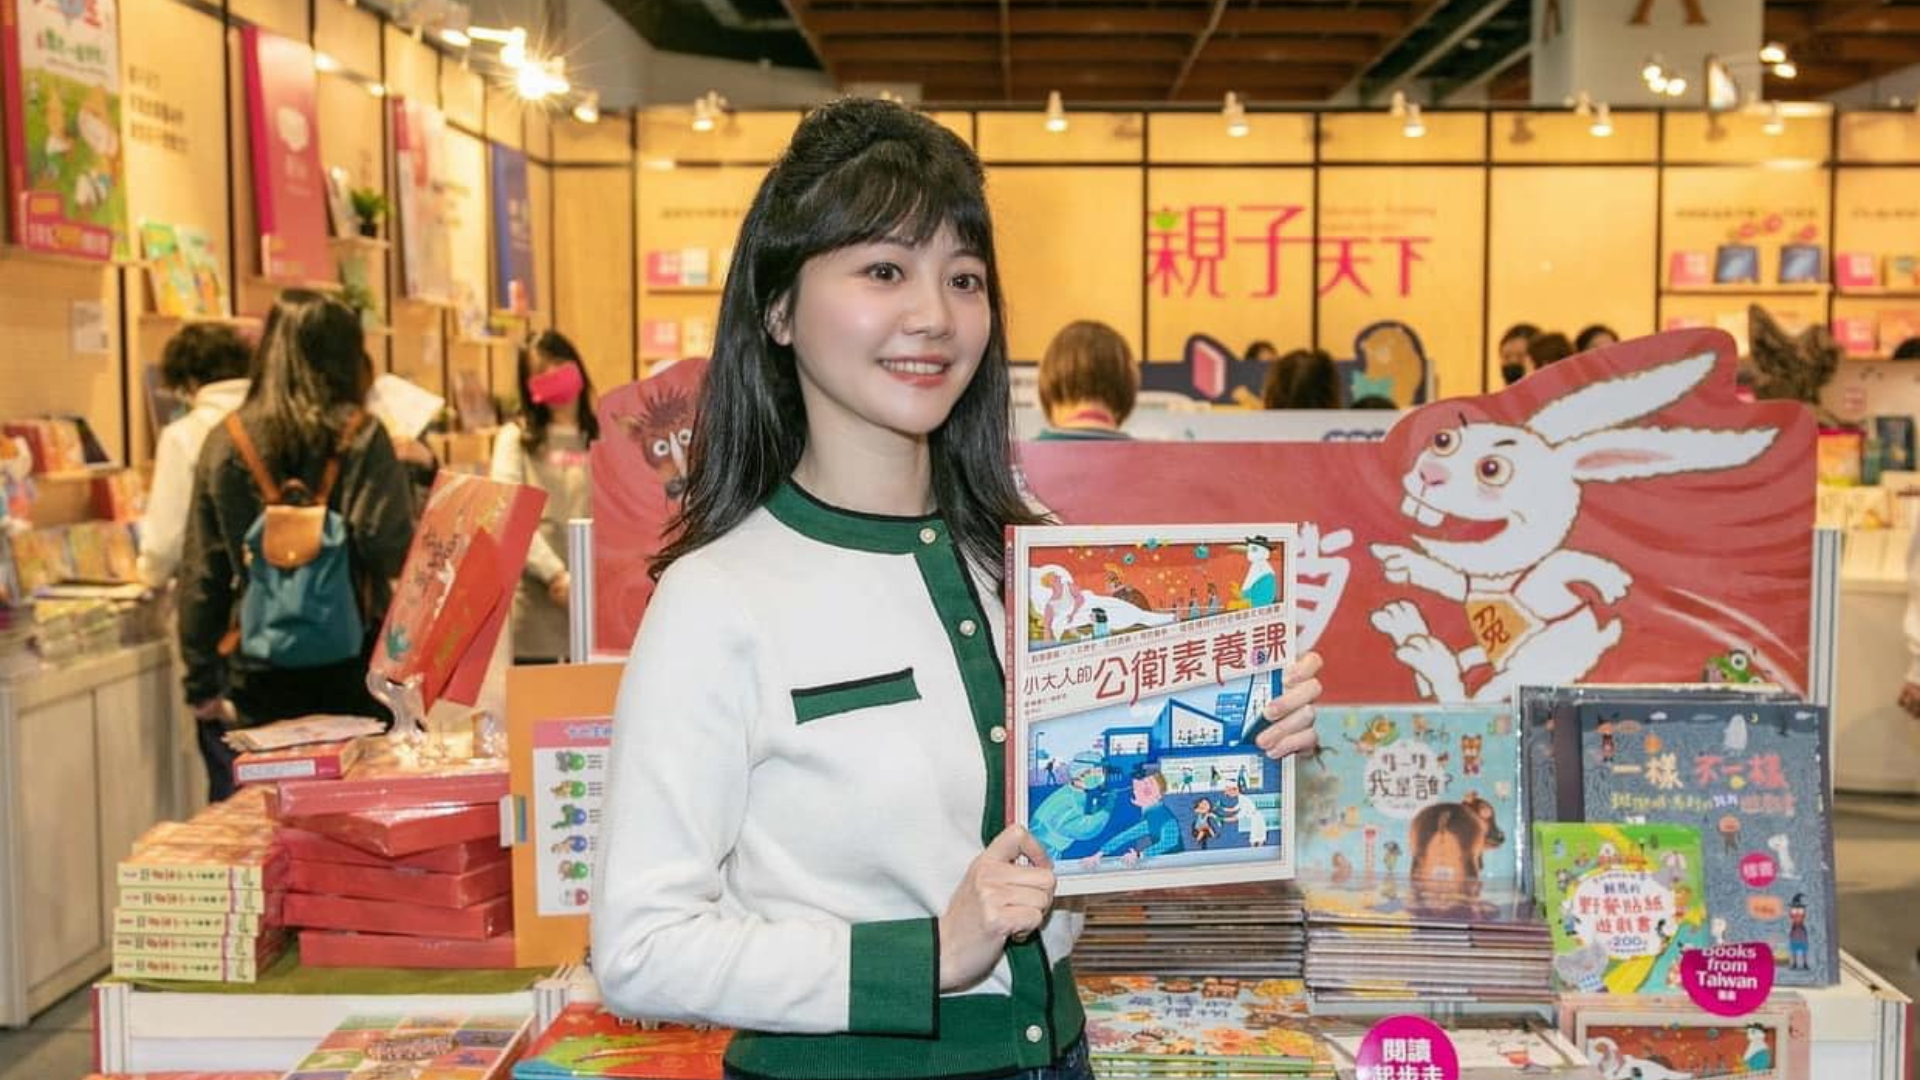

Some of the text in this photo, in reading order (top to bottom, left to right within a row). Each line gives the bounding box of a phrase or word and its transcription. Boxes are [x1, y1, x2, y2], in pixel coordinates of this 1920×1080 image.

[1145, 205, 1431, 298] 親子天下
[1472, 604, 1511, 652] 兔
[1611, 752, 1684, 790] 一樣
[1696, 970, 1758, 989] Taiwan
[1707, 957, 1749, 973] from
[1382, 1038, 1432, 1063] 閱讀
